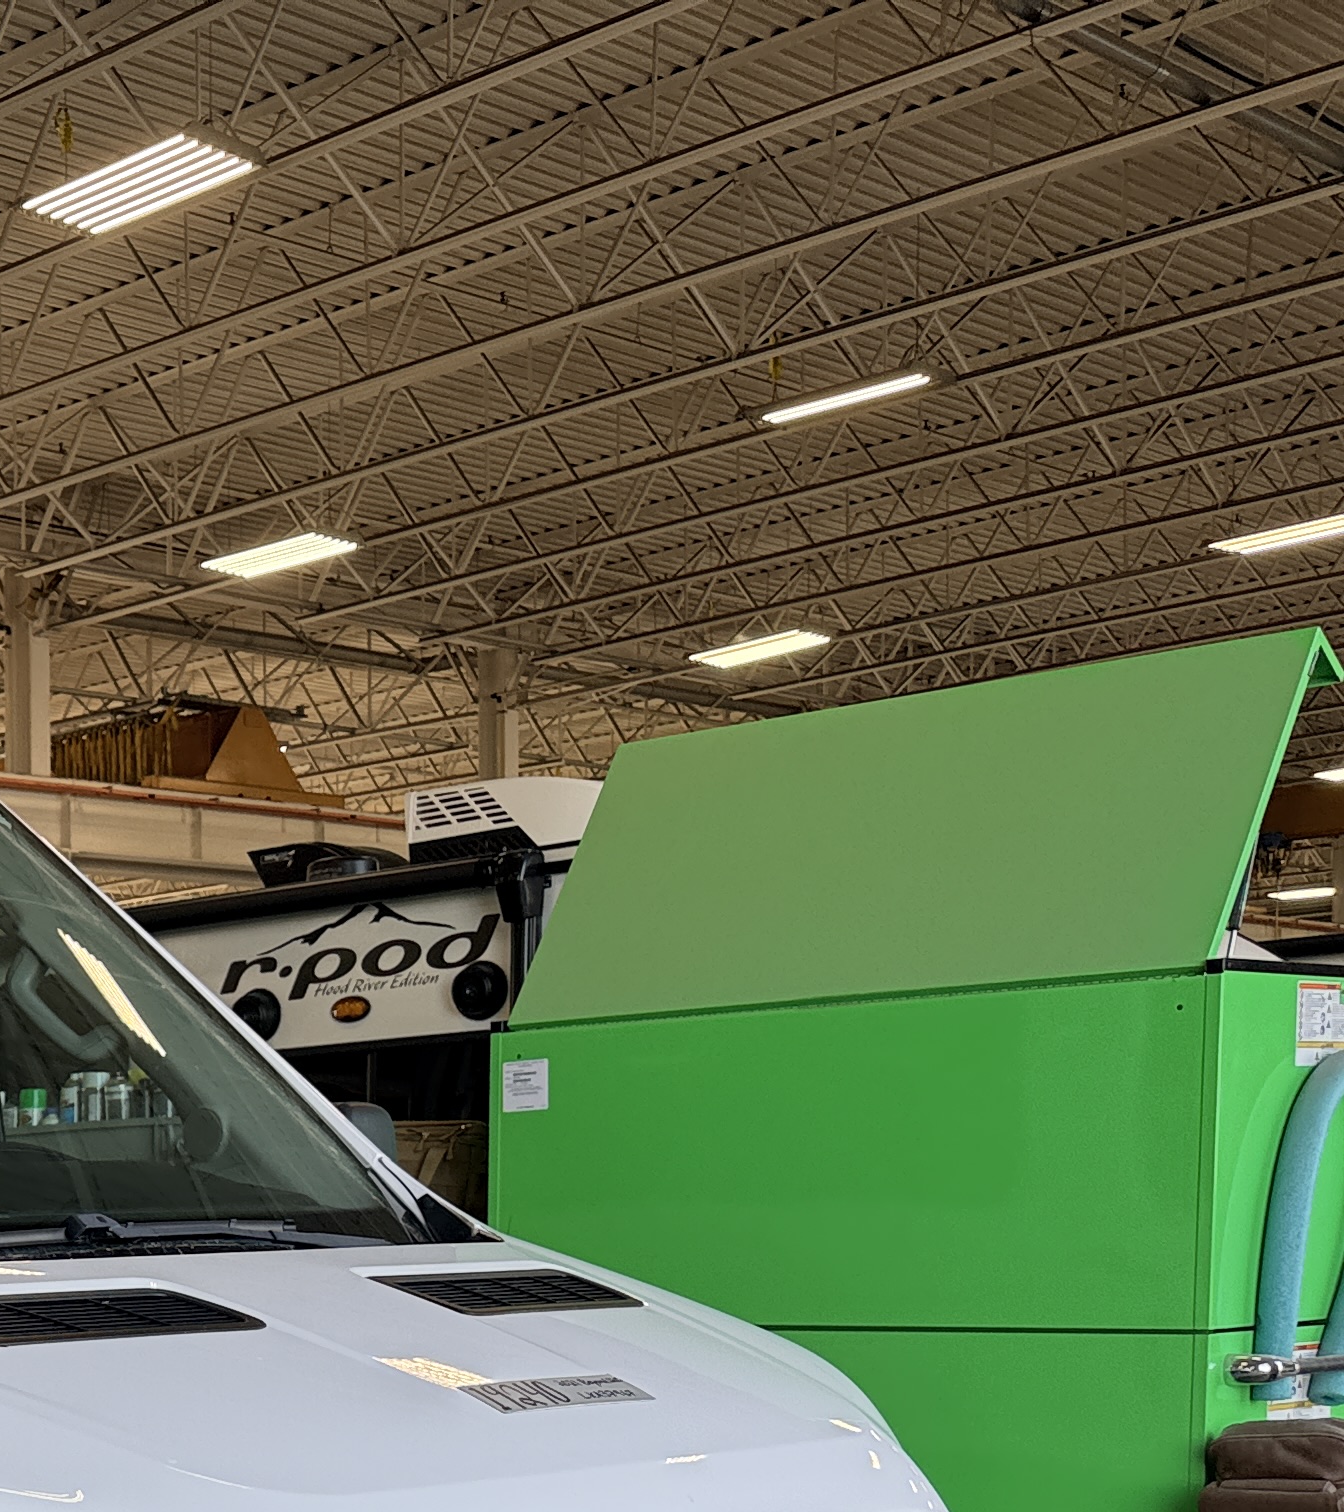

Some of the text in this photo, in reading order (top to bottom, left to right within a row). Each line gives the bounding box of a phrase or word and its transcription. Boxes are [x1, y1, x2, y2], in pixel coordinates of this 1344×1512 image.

[314, 972, 439, 997] Hood River Edition
